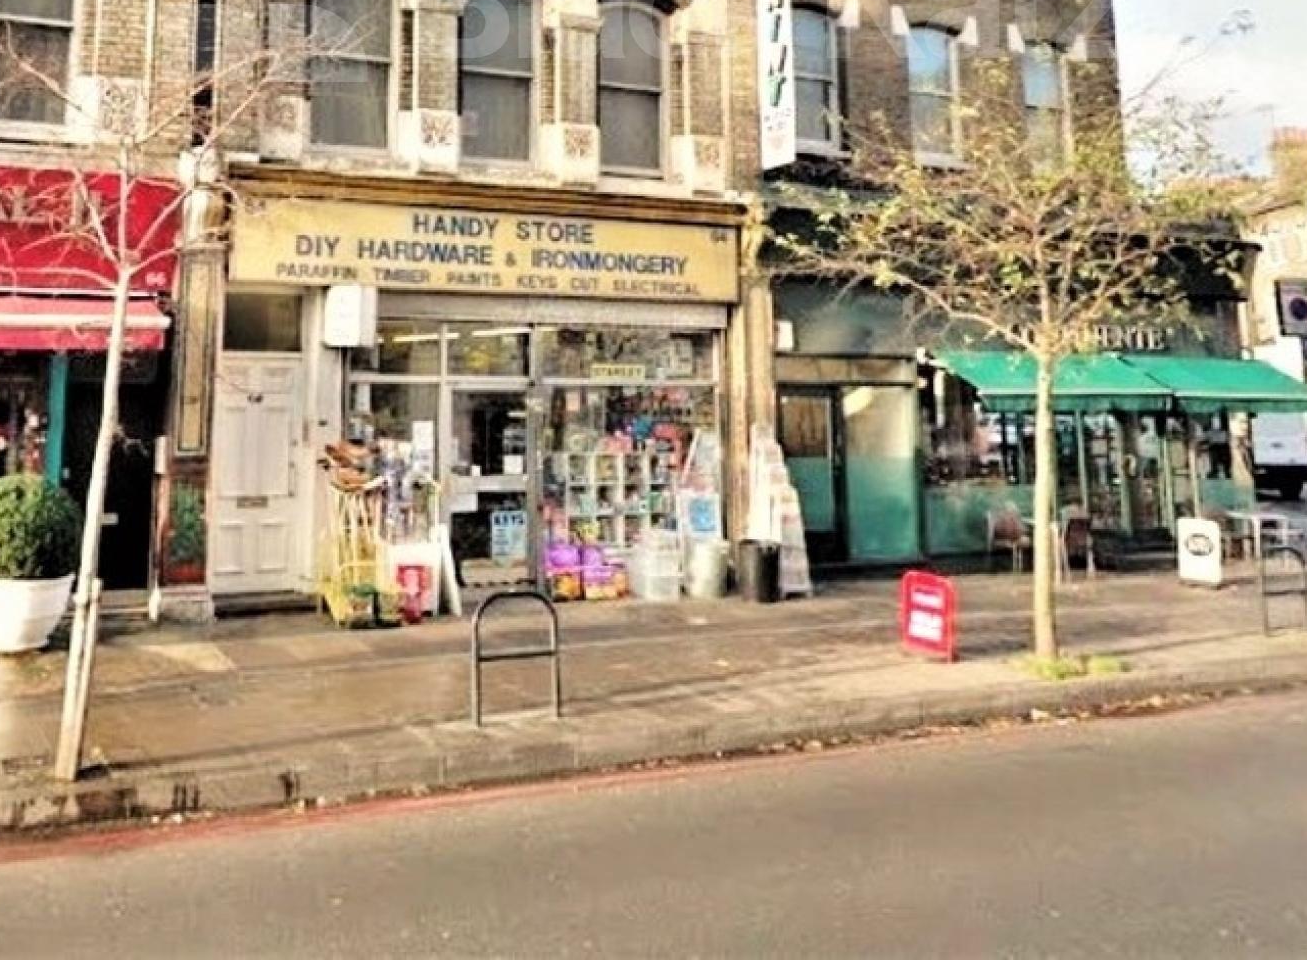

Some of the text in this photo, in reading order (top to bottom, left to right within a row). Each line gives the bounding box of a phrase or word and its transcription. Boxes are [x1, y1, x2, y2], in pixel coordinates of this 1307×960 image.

[412, 212, 594, 244] HANDY STORE
[295, 234, 340, 258] DIY
[357, 238, 492, 266] HARDWARE
[531, 247, 689, 276] IRONMONGERY
[276, 262, 702, 297] PARAFFIN TIMBER PAINTS KEYS CUT ELECTRICAL
